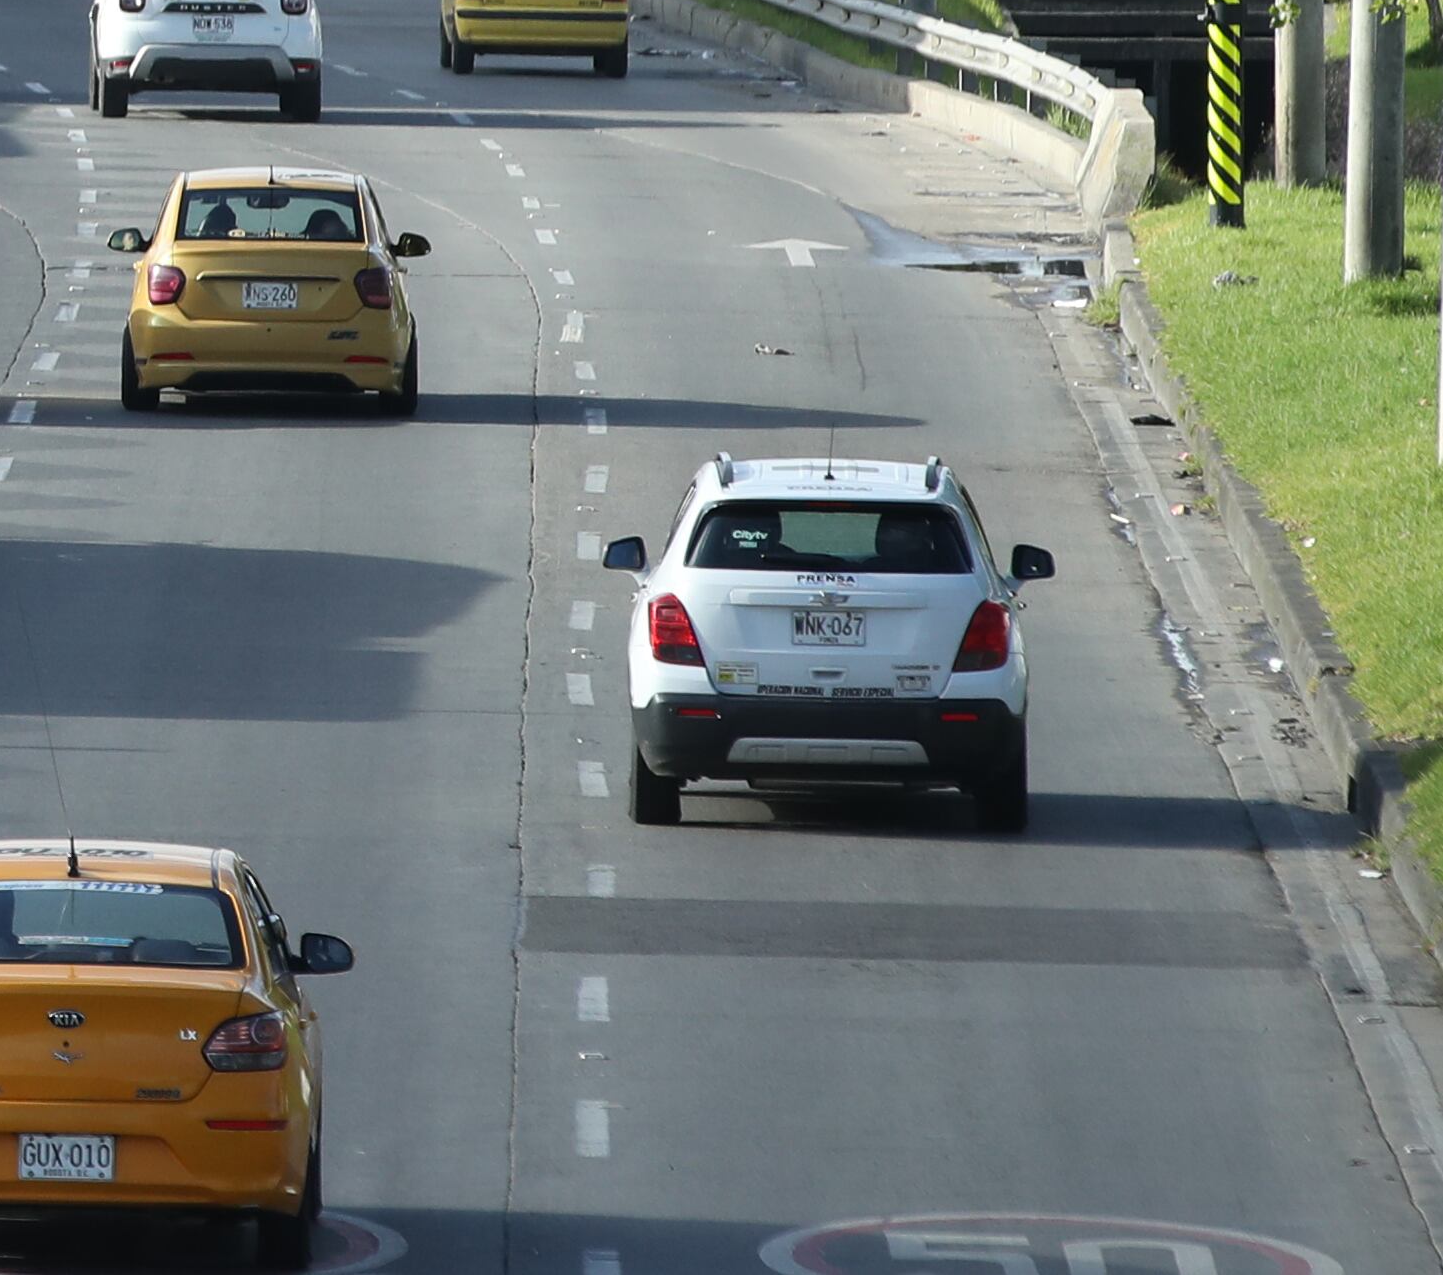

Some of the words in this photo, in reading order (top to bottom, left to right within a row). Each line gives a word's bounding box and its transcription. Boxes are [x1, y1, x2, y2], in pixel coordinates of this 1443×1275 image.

[732, 530, 768, 541] Citytv
[796, 574, 856, 583] PRENSA
[54, 1014, 82, 1025] KIA
[180, 1028, 198, 1041] LX
[884, 1230, 1215, 1275] 50
